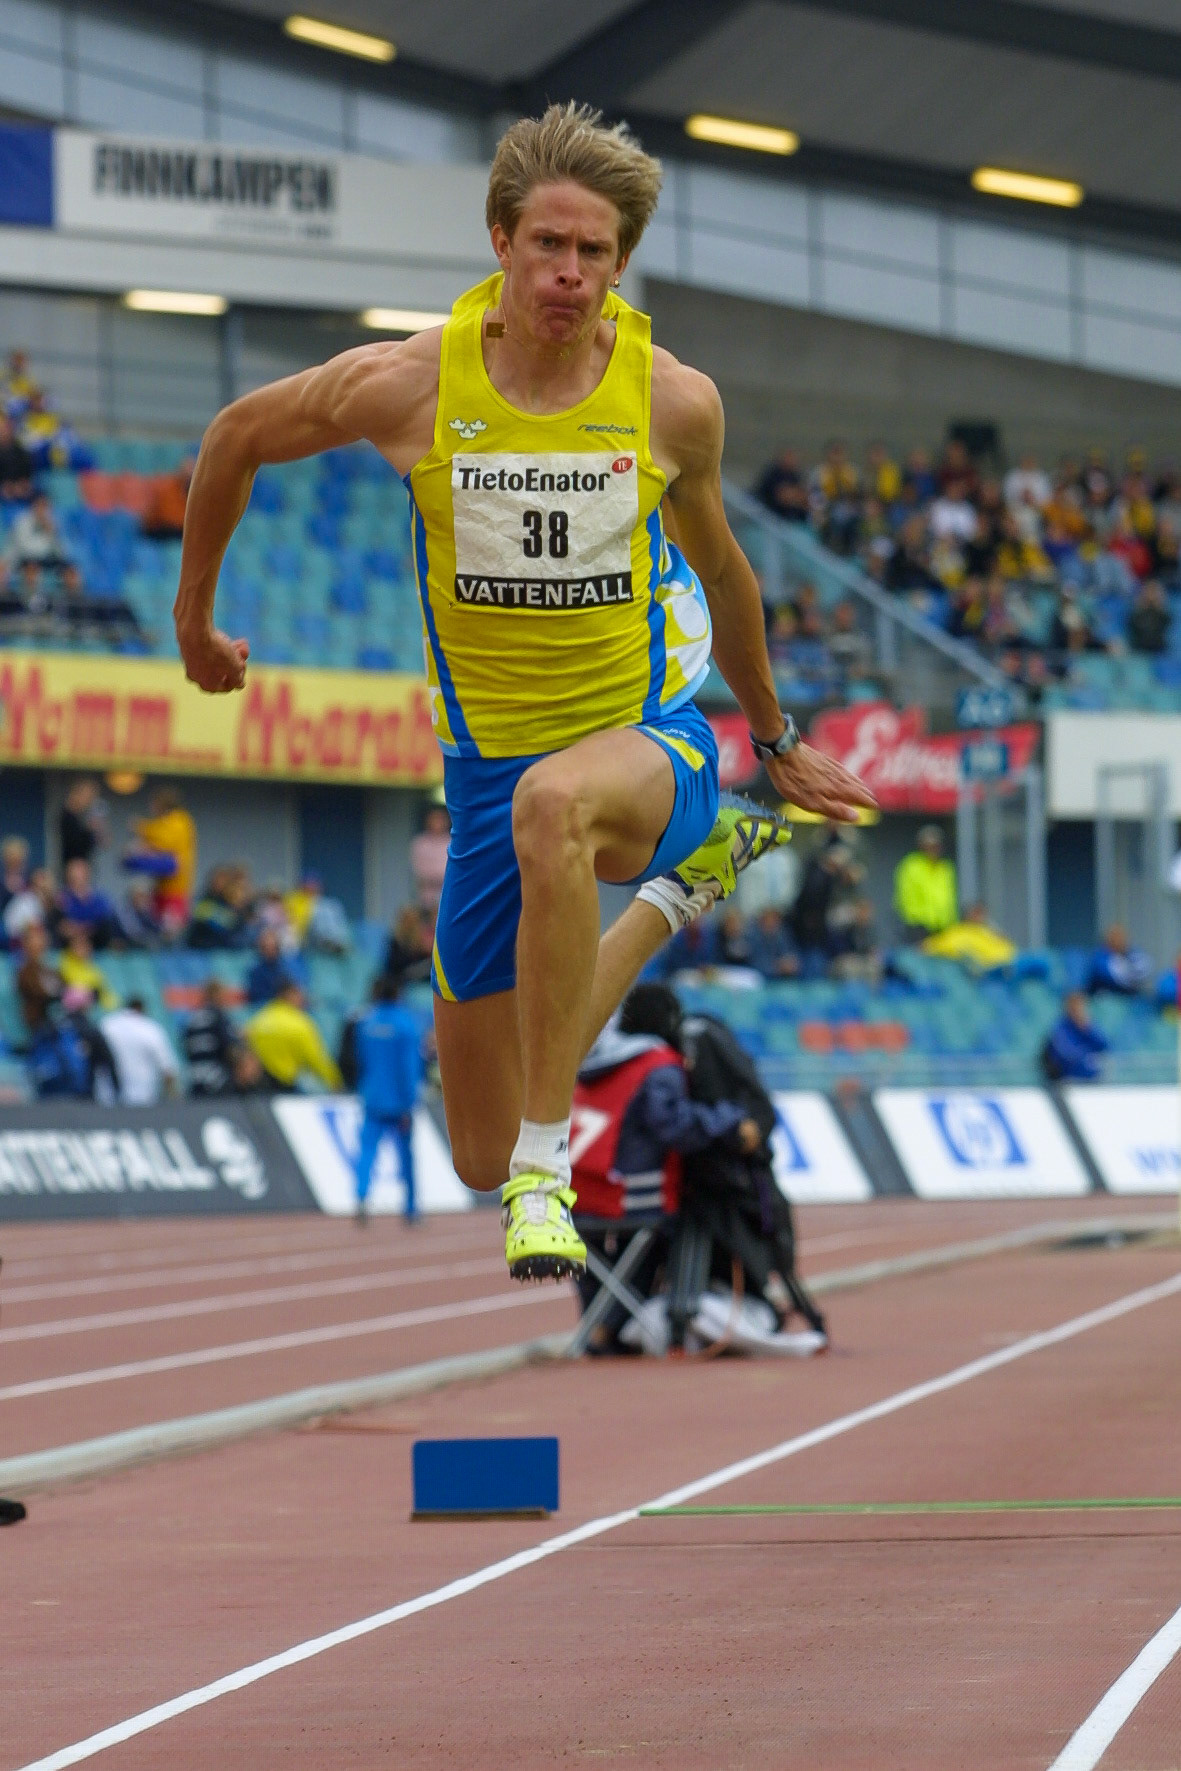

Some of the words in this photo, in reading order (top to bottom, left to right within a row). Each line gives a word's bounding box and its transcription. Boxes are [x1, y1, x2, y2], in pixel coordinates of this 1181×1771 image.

[458, 467, 610, 492] TietoEnator
[523, 510, 569, 558] 38
[457, 577, 630, 606] VATTENFALL
